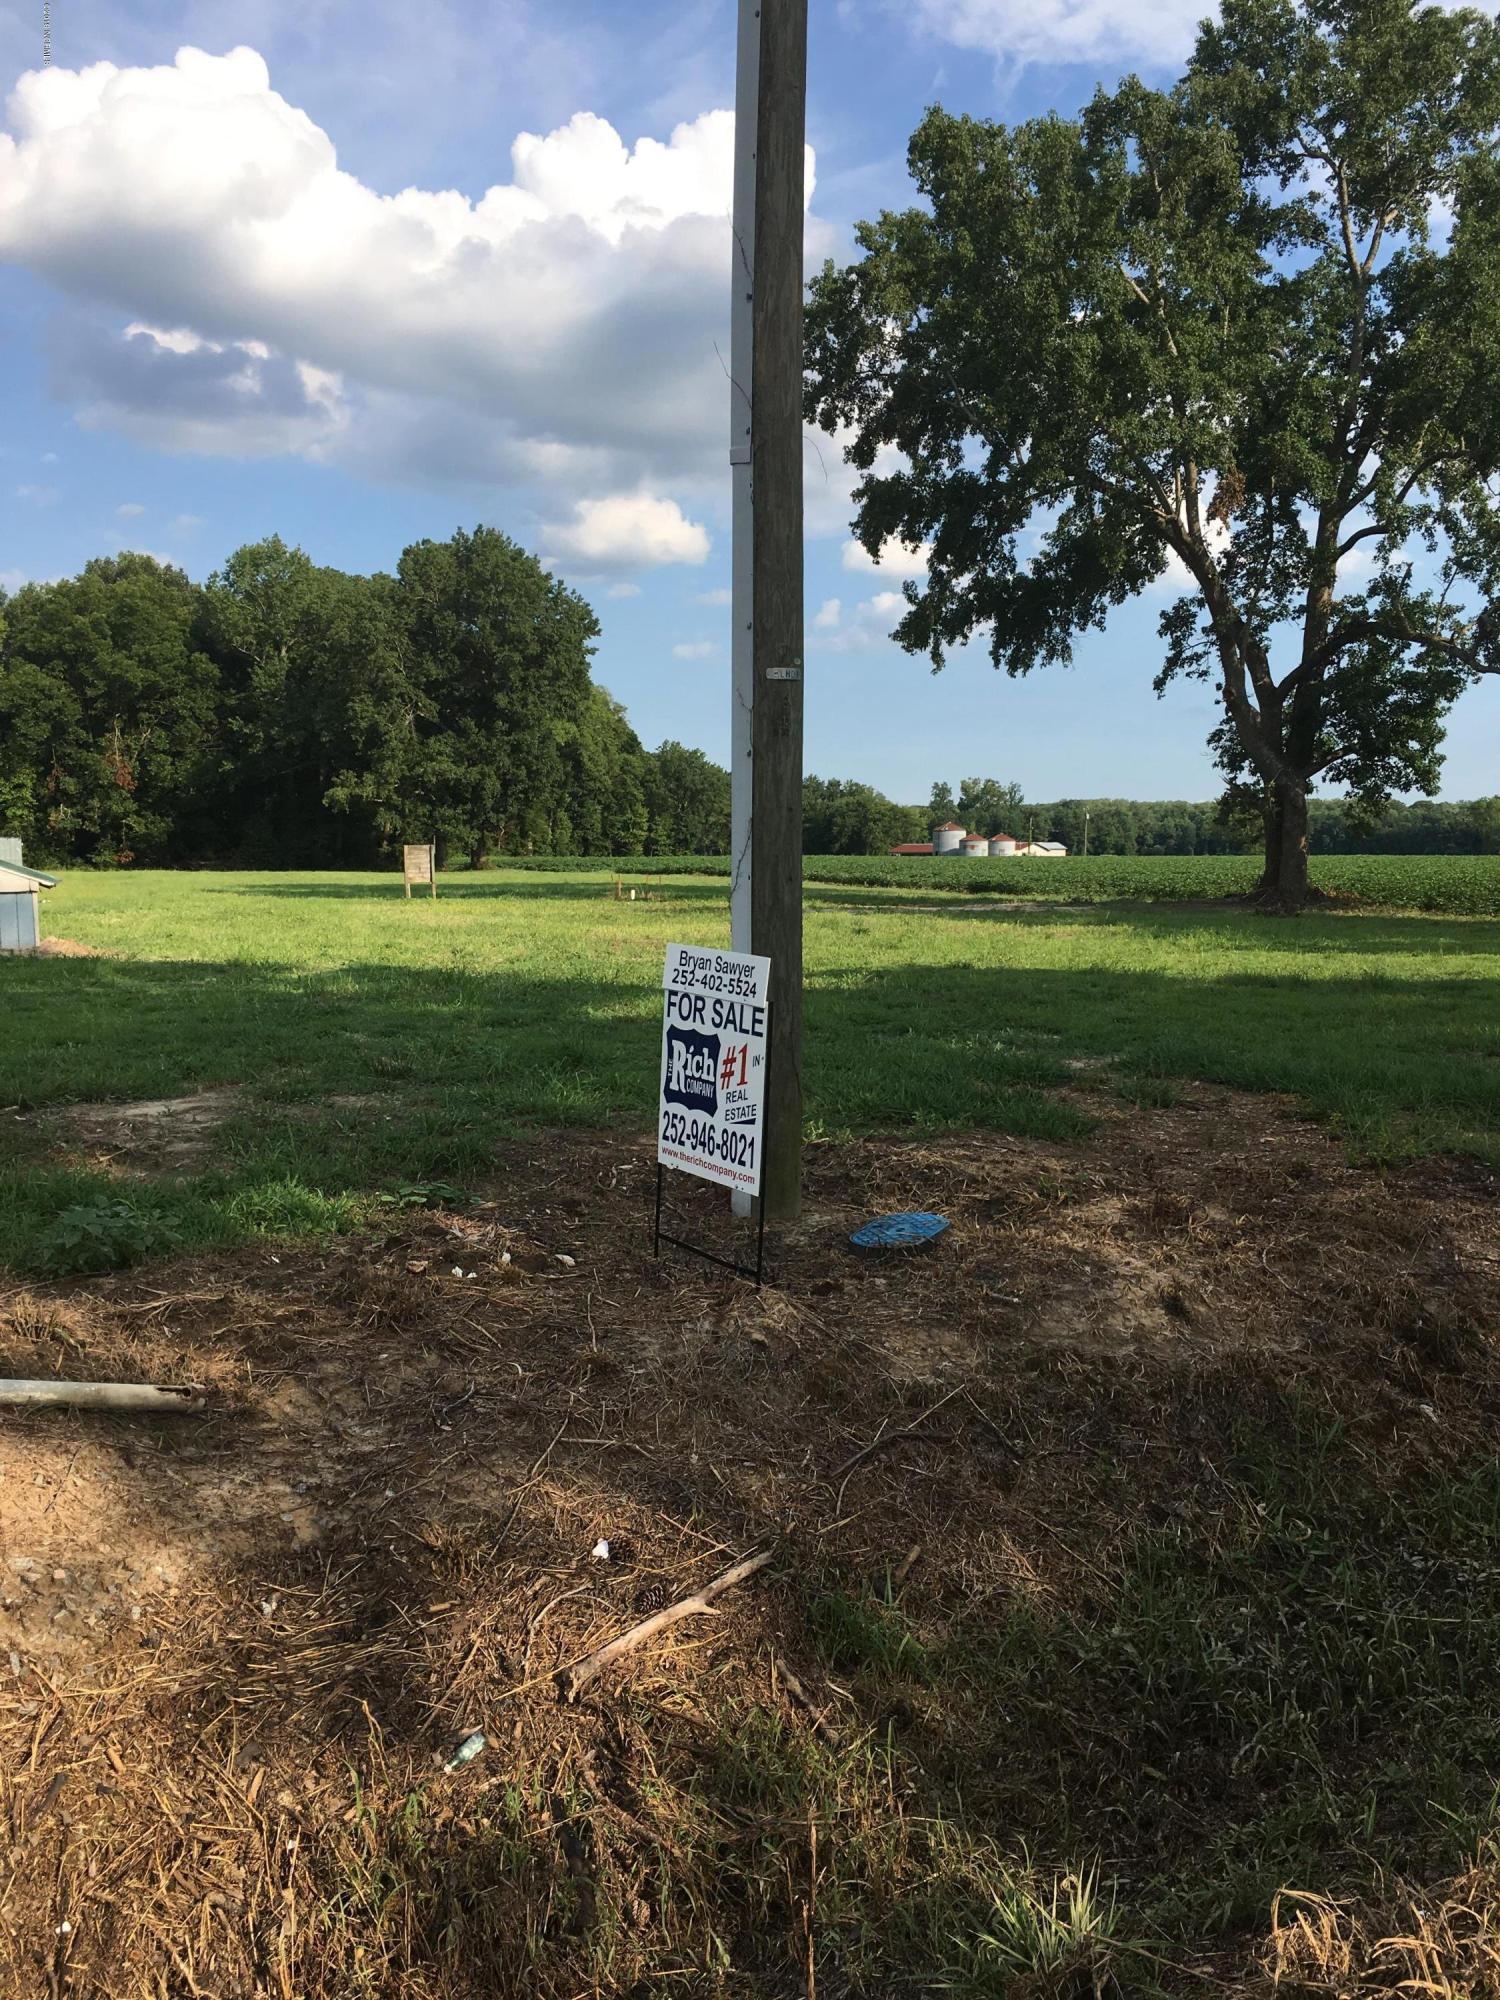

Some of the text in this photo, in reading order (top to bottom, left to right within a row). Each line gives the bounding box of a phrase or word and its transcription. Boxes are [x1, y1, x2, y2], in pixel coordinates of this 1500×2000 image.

[679, 950, 756, 979] Bryan Sawyer
[672, 968, 757, 998] 252-402-5524
[667, 990, 765, 1037] FOR SALE
[669, 1040, 715, 1093] Rich
[720, 1043, 749, 1090] #1
[686, 1079, 715, 1098] COMPANY
[725, 1089, 749, 1104] REAL
[724, 1104, 757, 1121] ESTATE
[662, 1110, 755, 1169] 252-946-8021
[661, 1146, 755, 1184] www.therichcompany.com
